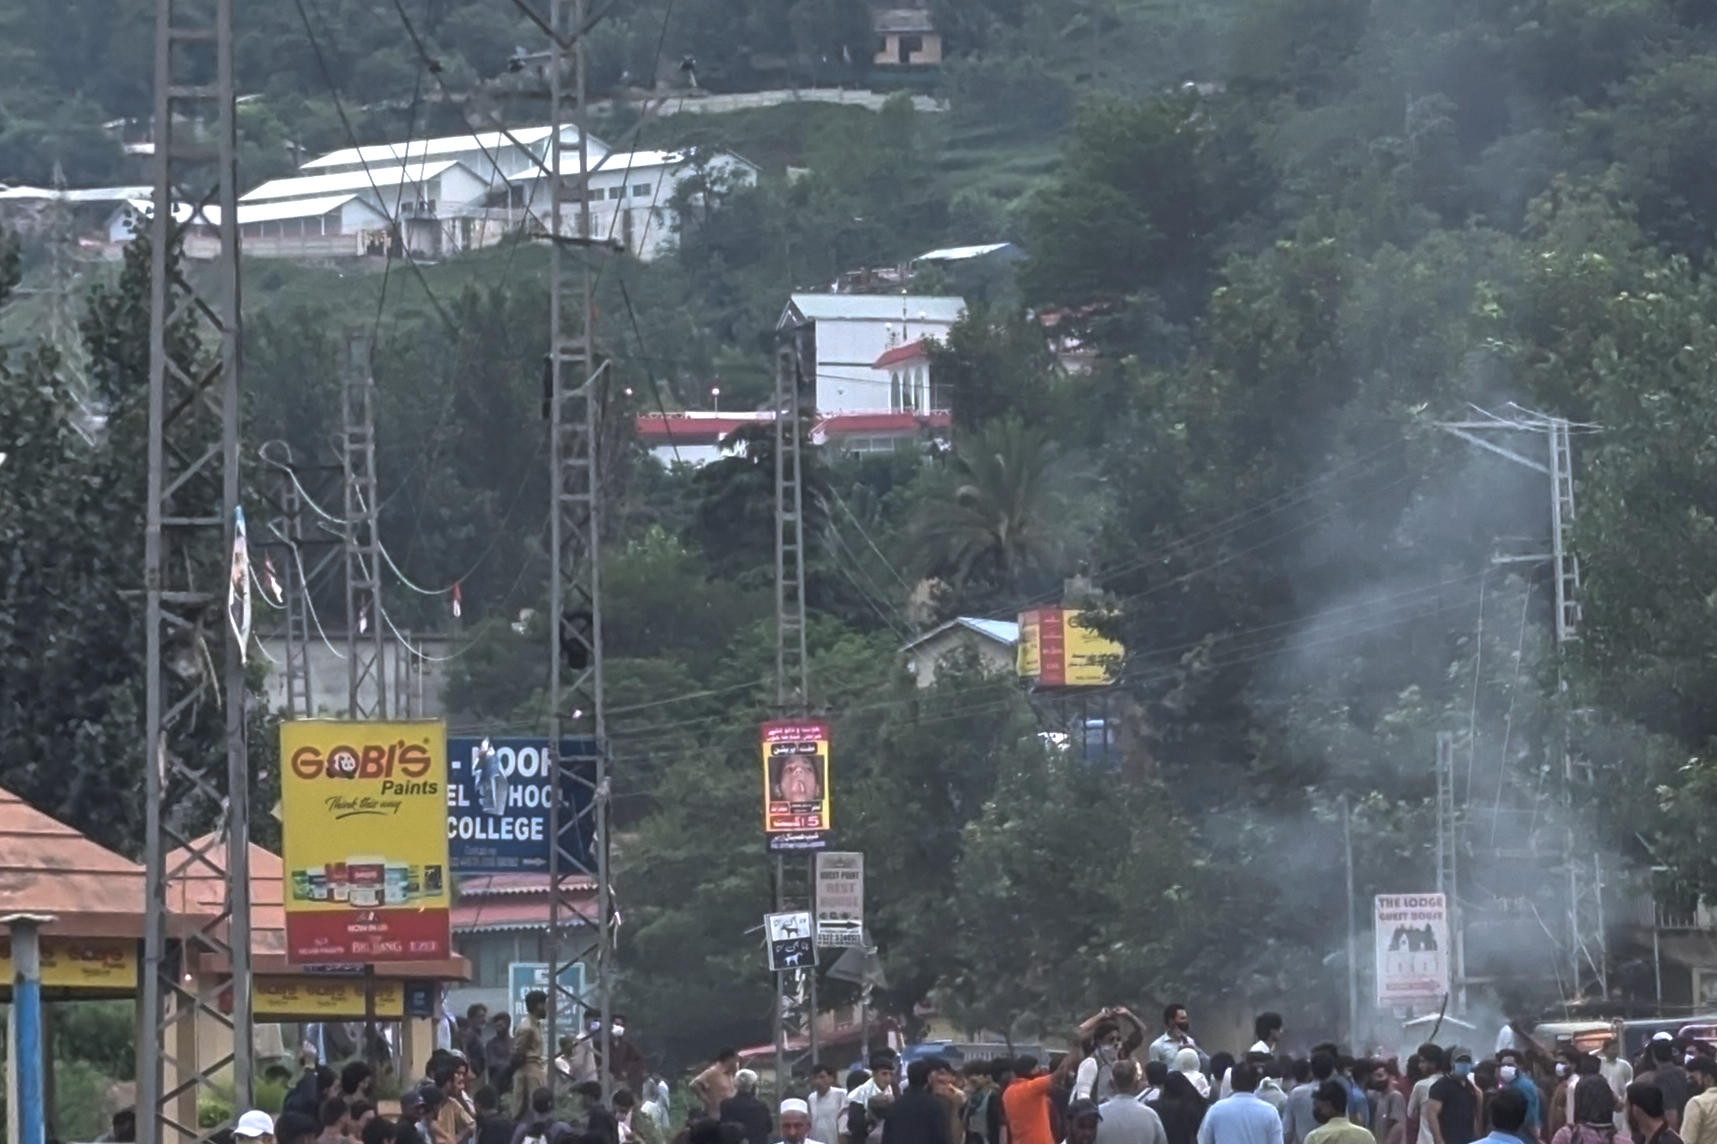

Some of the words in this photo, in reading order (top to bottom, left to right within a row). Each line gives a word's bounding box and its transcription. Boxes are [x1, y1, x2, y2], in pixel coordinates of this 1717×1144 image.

[291, 740, 432, 780] GOBI'S
[381, 780, 438, 795] Paints
[1379, 898, 1401, 908] THE
[1403, 898, 1443, 908] LODGE
